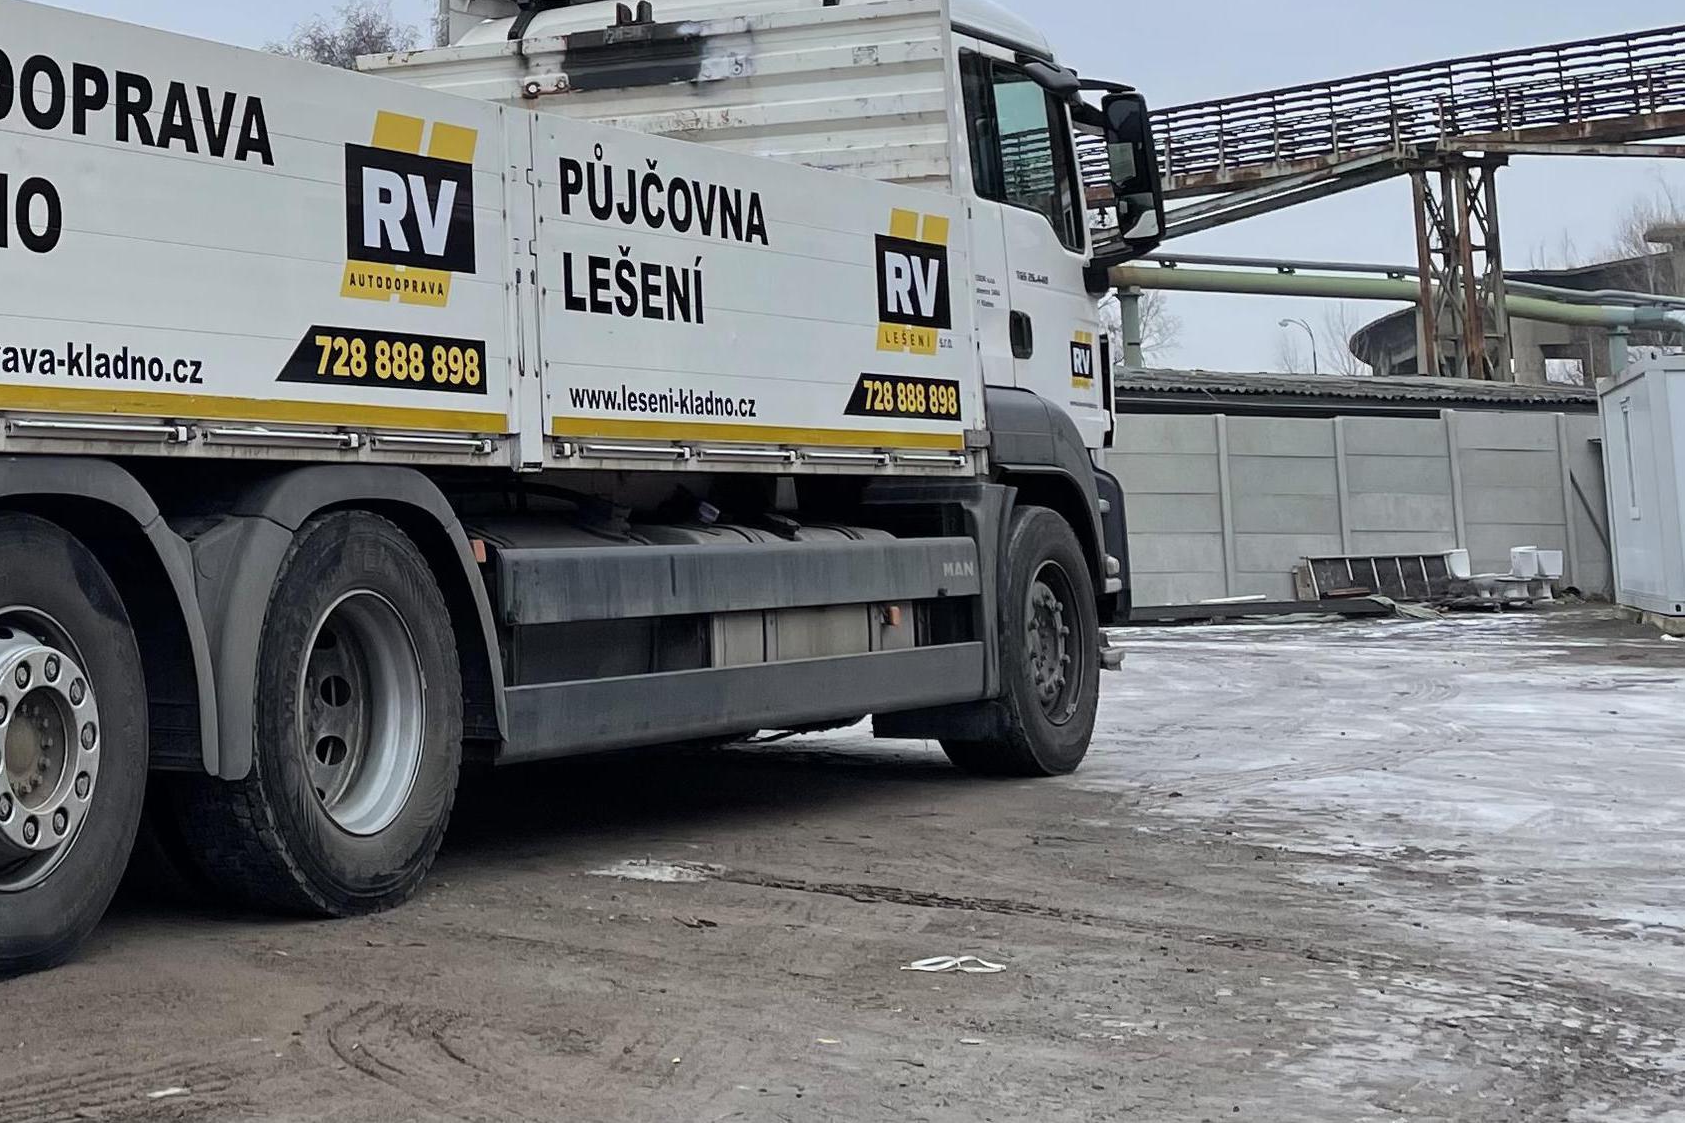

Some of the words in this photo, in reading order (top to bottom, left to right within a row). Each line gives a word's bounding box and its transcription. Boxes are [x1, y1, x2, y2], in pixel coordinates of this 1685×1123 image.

[361, 165, 458, 257] RV
[559, 142, 769, 246] PŮJČOVNA
[349, 272, 444, 296] AUTODOPRAVA
[562, 244, 704, 325] LEŠENÍ
[884, 250, 940, 318] RV
[884, 329, 931, 348] LEŠENÍ
[315, 335, 368, 378] 728
[375, 339, 425, 382] 888
[432, 344, 480, 386] 898
[1072, 346, 1090, 375] RV
[568, 383, 757, 418] www.leseni-kladno.cz
[863, 379, 894, 412] 728
[897, 382, 926, 413] 888
[929, 384, 958, 416] 898
[942, 561, 974, 577] MAN
